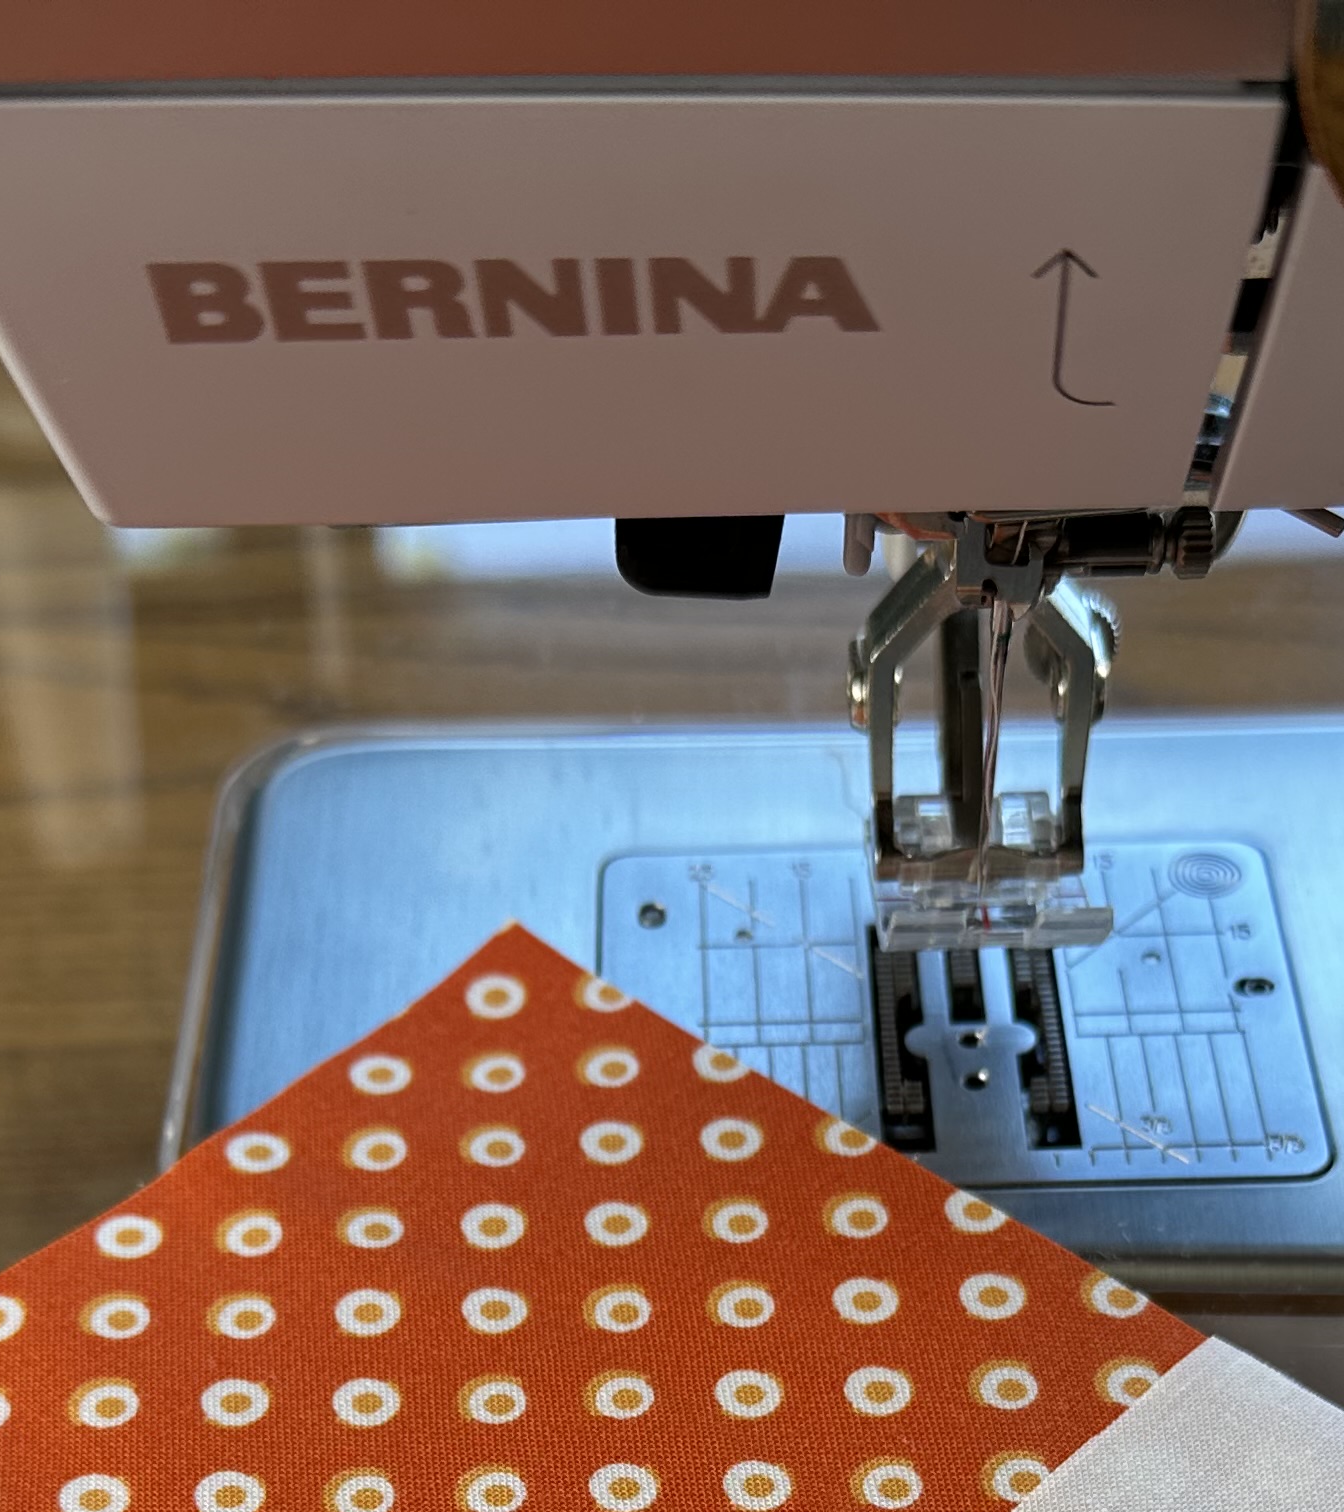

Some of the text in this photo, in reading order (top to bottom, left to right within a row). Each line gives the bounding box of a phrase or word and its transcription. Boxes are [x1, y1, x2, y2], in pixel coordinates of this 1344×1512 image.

[146, 256, 881, 344] BERNINA
[1093, 853, 1114, 870] 15
[1230, 923, 1252, 941] 15
